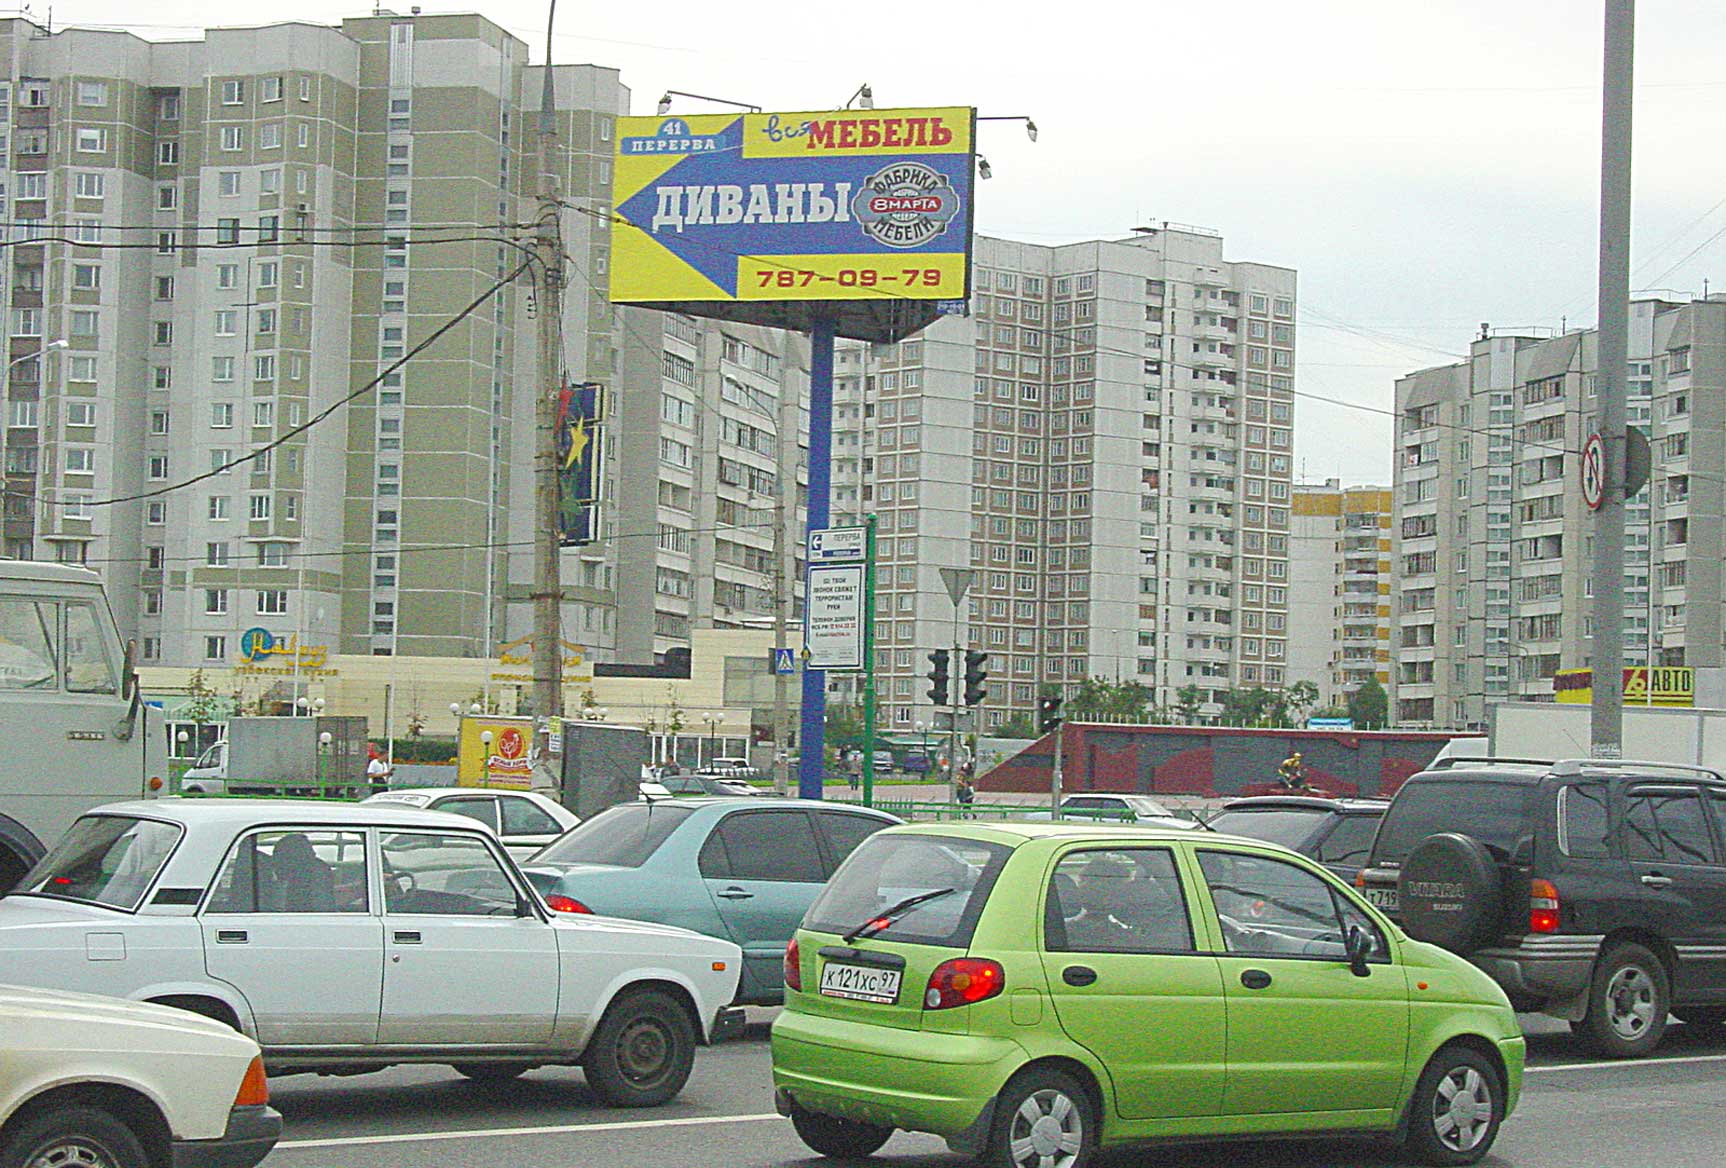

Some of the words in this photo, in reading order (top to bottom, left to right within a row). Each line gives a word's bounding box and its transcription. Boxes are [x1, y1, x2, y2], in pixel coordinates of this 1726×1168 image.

[663, 121, 682, 135] 41
[807, 117, 953, 150] МЕБЕЛЬ
[631, 138, 716, 152] ПЕРЕРВА
[873, 168, 938, 195] ФАБРИКА
[652, 182, 851, 234] ДИВАНЫ
[873, 217, 935, 241] МЕБЕЛИ
[757, 268, 942, 288] 787-09-79
[1652, 669, 1690, 692] АВТО
